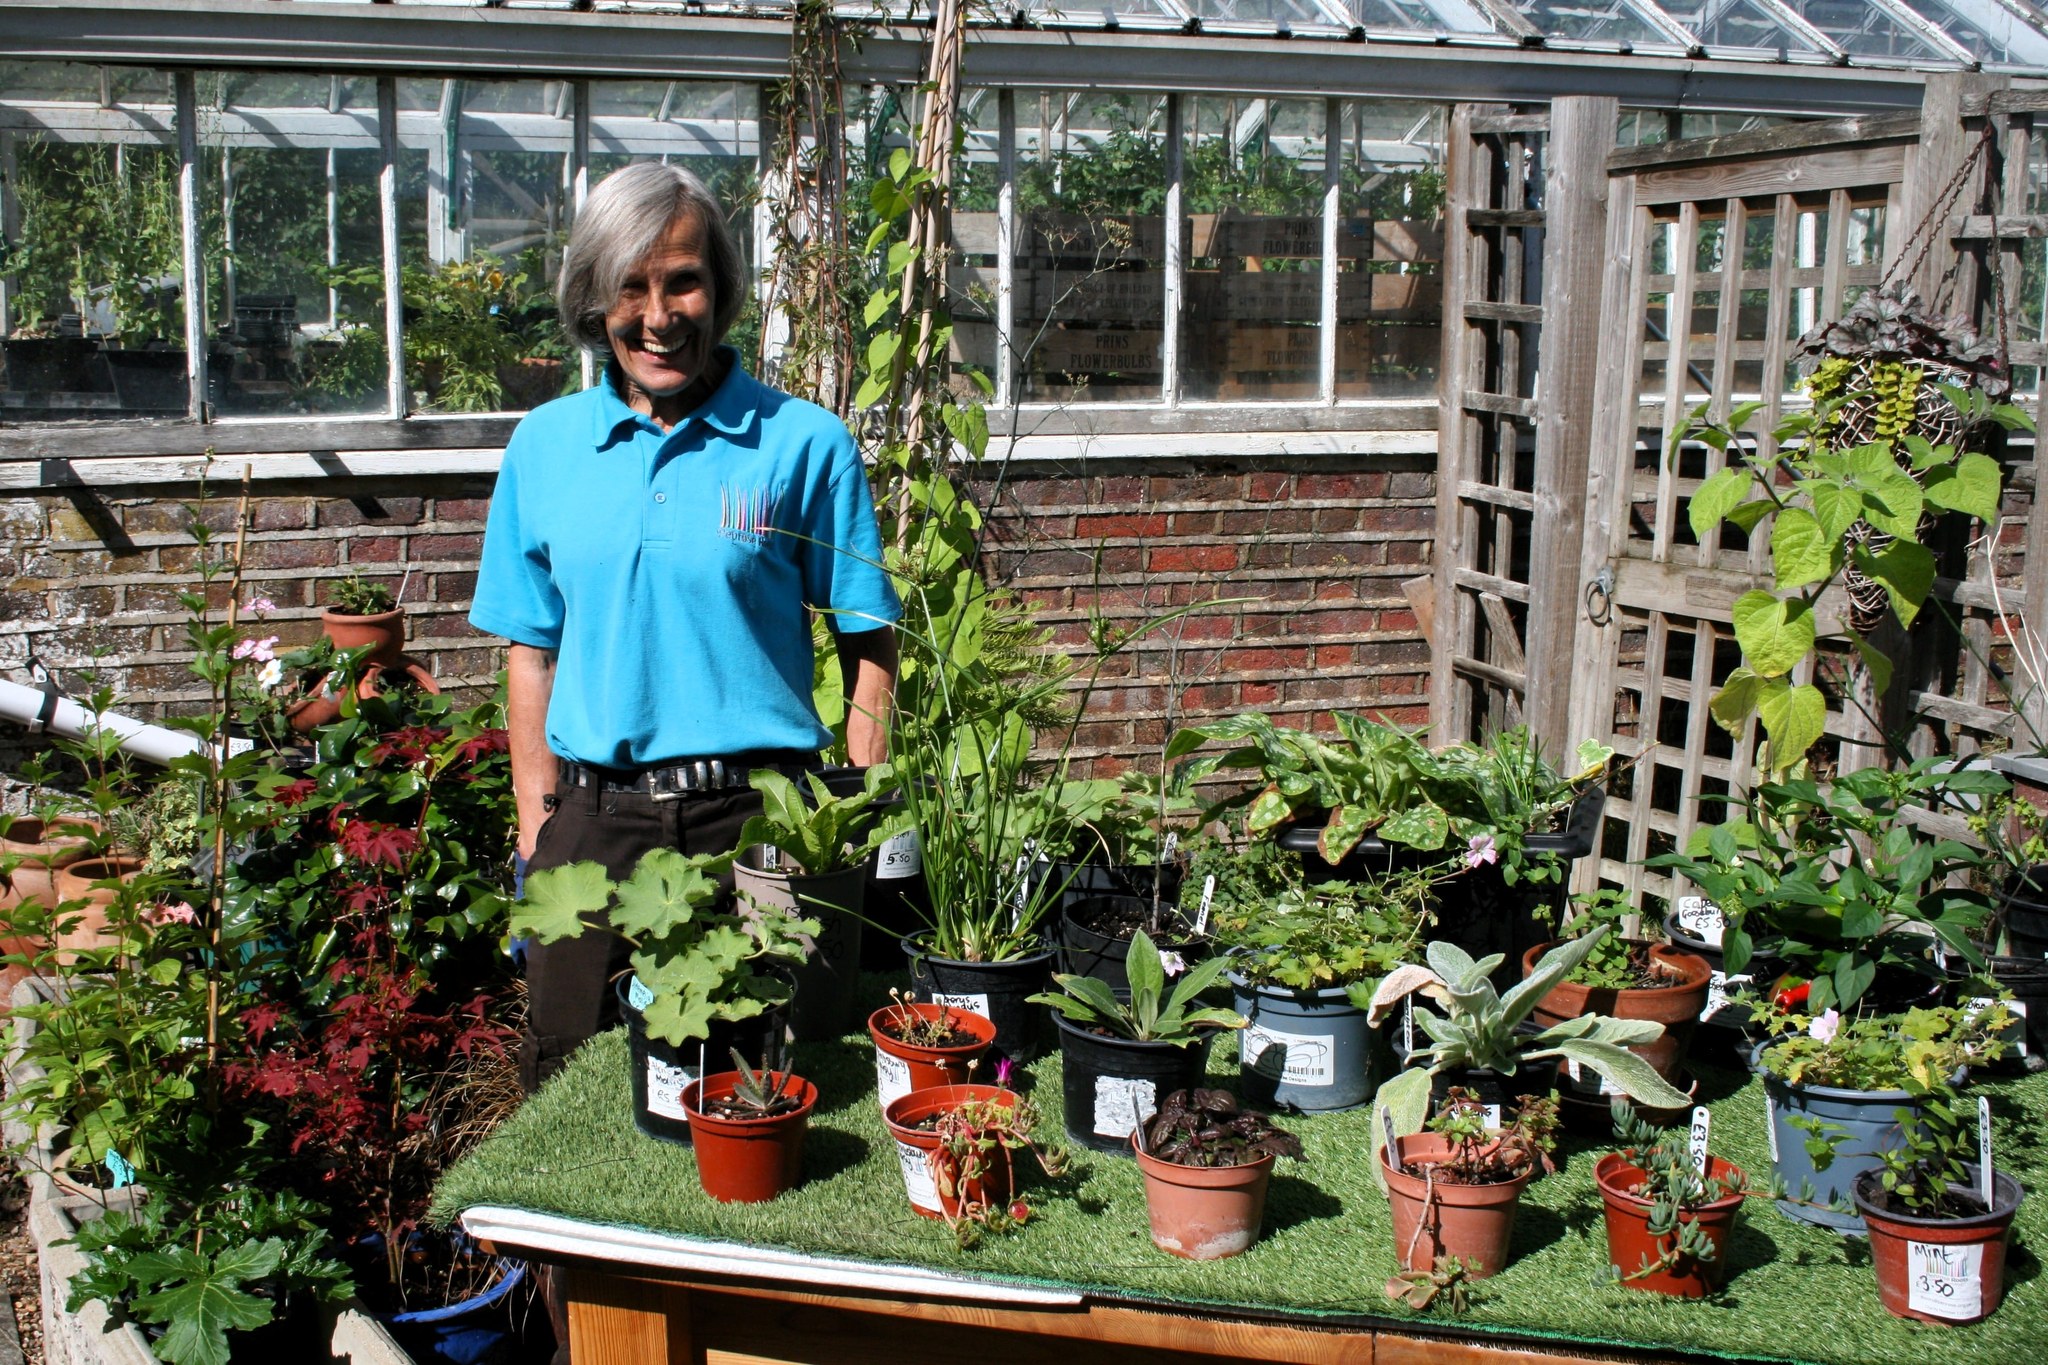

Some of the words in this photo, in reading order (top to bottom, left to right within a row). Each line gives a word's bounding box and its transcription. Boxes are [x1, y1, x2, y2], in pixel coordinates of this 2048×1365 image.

[1095, 334, 1129, 349] PRINS
[1070, 353, 1152, 369] FLOWERBULBS
[1695, 916, 1731, 929] £5.50
[1692, 1123, 1707, 1167] £3.50
[1914, 1244, 1954, 1265] Mint
